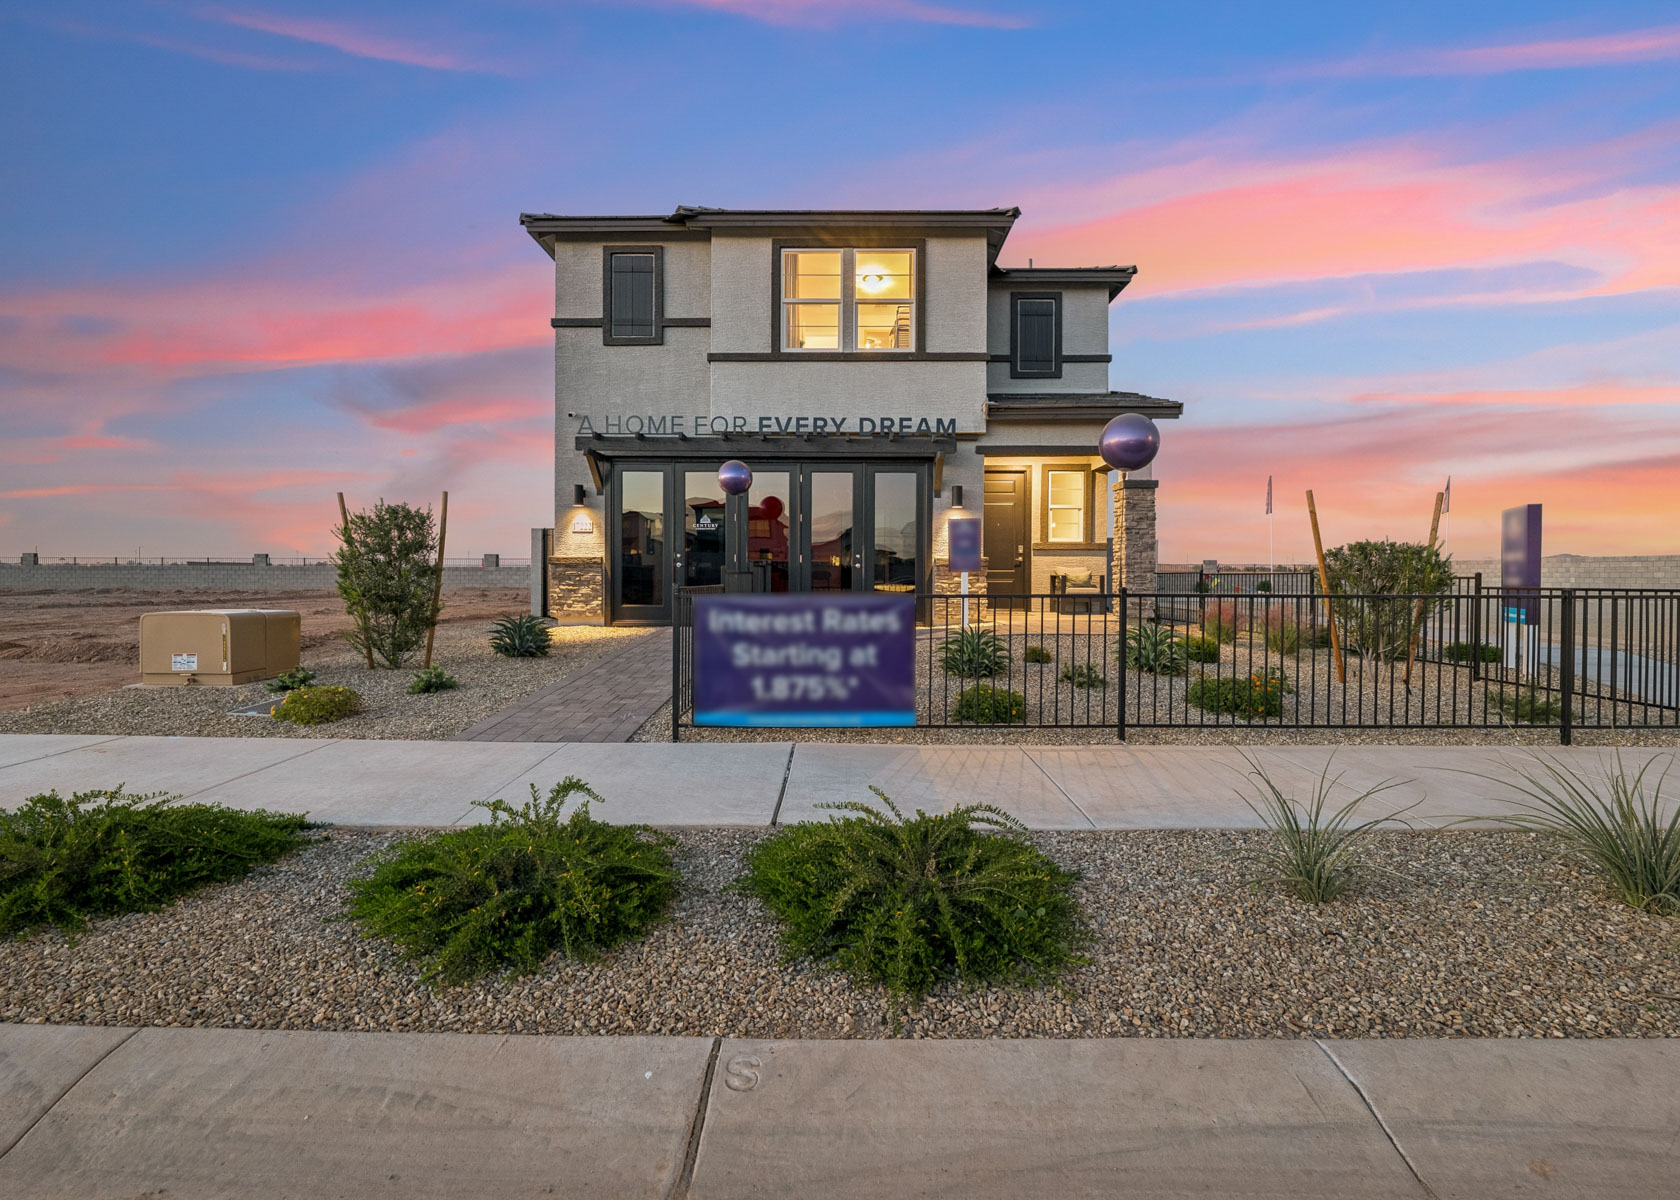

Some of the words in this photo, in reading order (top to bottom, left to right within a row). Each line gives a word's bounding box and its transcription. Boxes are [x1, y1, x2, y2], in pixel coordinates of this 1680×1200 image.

[578, 415, 593, 434] A
[605, 415, 684, 435] HOME
[695, 416, 747, 435] FOR
[759, 416, 847, 436] EVERY
[859, 417, 956, 436] DREAM
[708, 609, 815, 632] Interest
[822, 609, 902, 632] Rates
[733, 643, 842, 671] Starting
[850, 645, 877, 666] at
